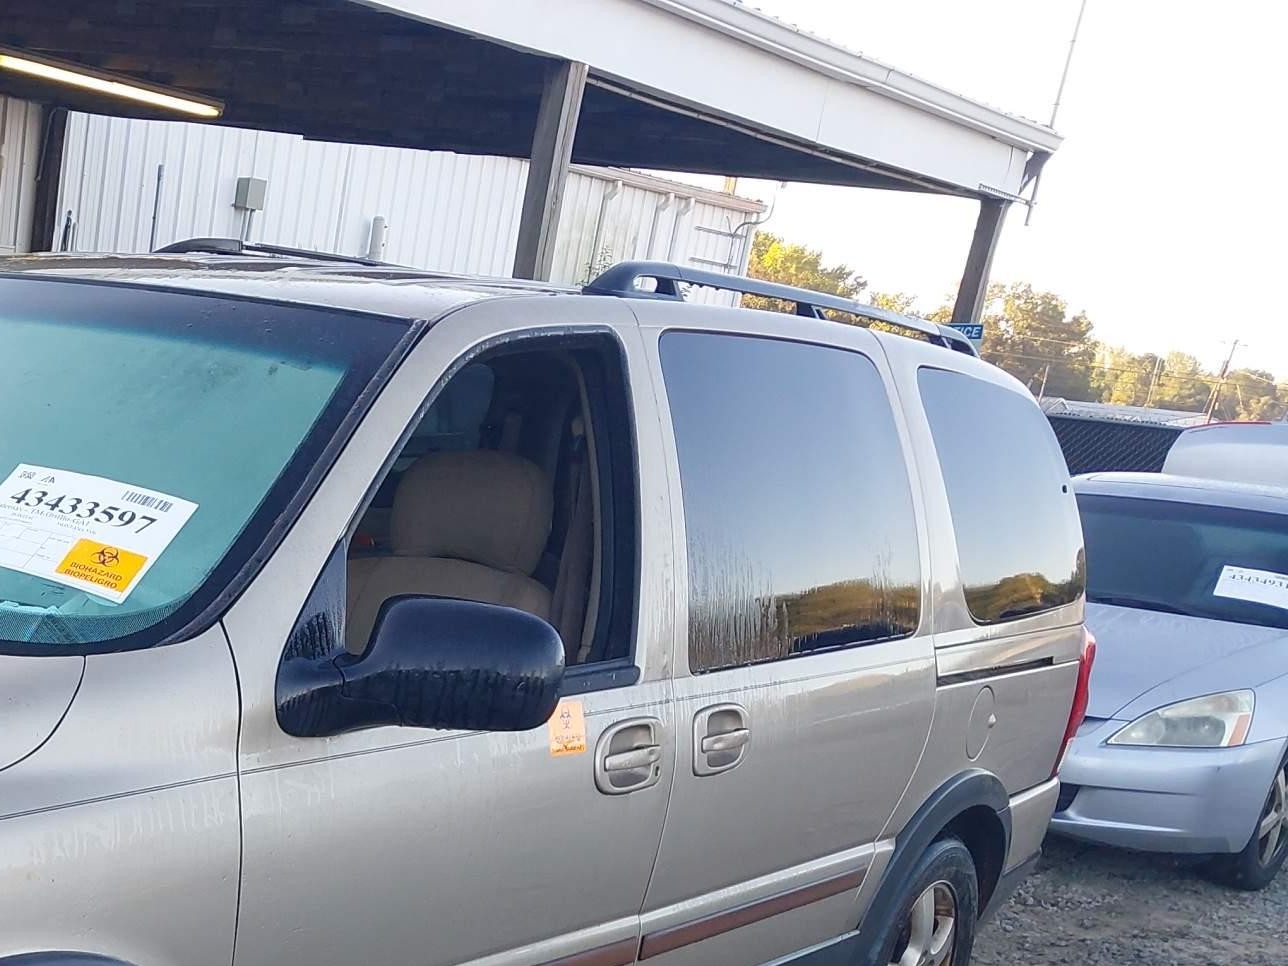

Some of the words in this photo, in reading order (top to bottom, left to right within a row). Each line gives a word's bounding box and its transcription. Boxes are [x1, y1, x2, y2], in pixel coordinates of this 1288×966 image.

[9, 488, 158, 534] 43433597
[63, 568, 118, 589] BIOPELIGRO
[69, 561, 123, 582] BIOHAZARD
